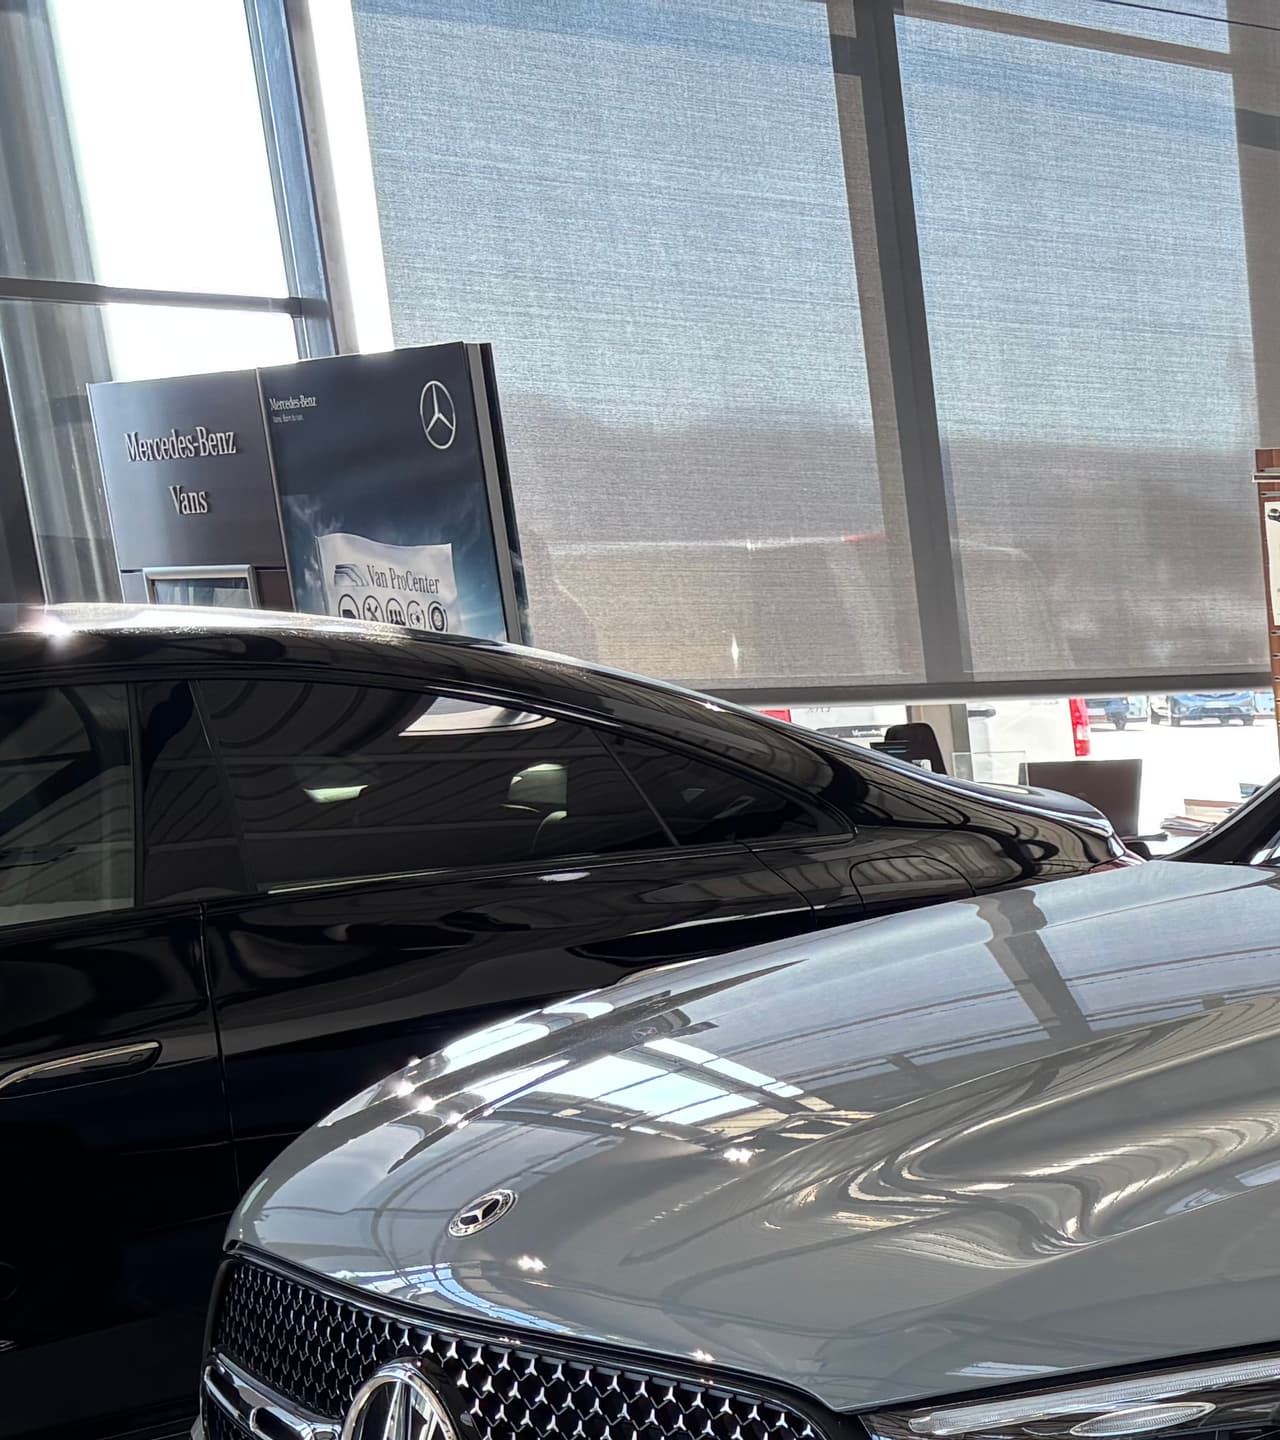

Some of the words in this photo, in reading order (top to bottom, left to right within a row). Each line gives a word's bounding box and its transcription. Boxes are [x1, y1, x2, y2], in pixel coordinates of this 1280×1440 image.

[124, 426, 237, 462] Mercedes-Benz
[168, 485, 208, 515] Vans
[366, 564, 389, 588] Van
[388, 567, 440, 594] ProCenter
